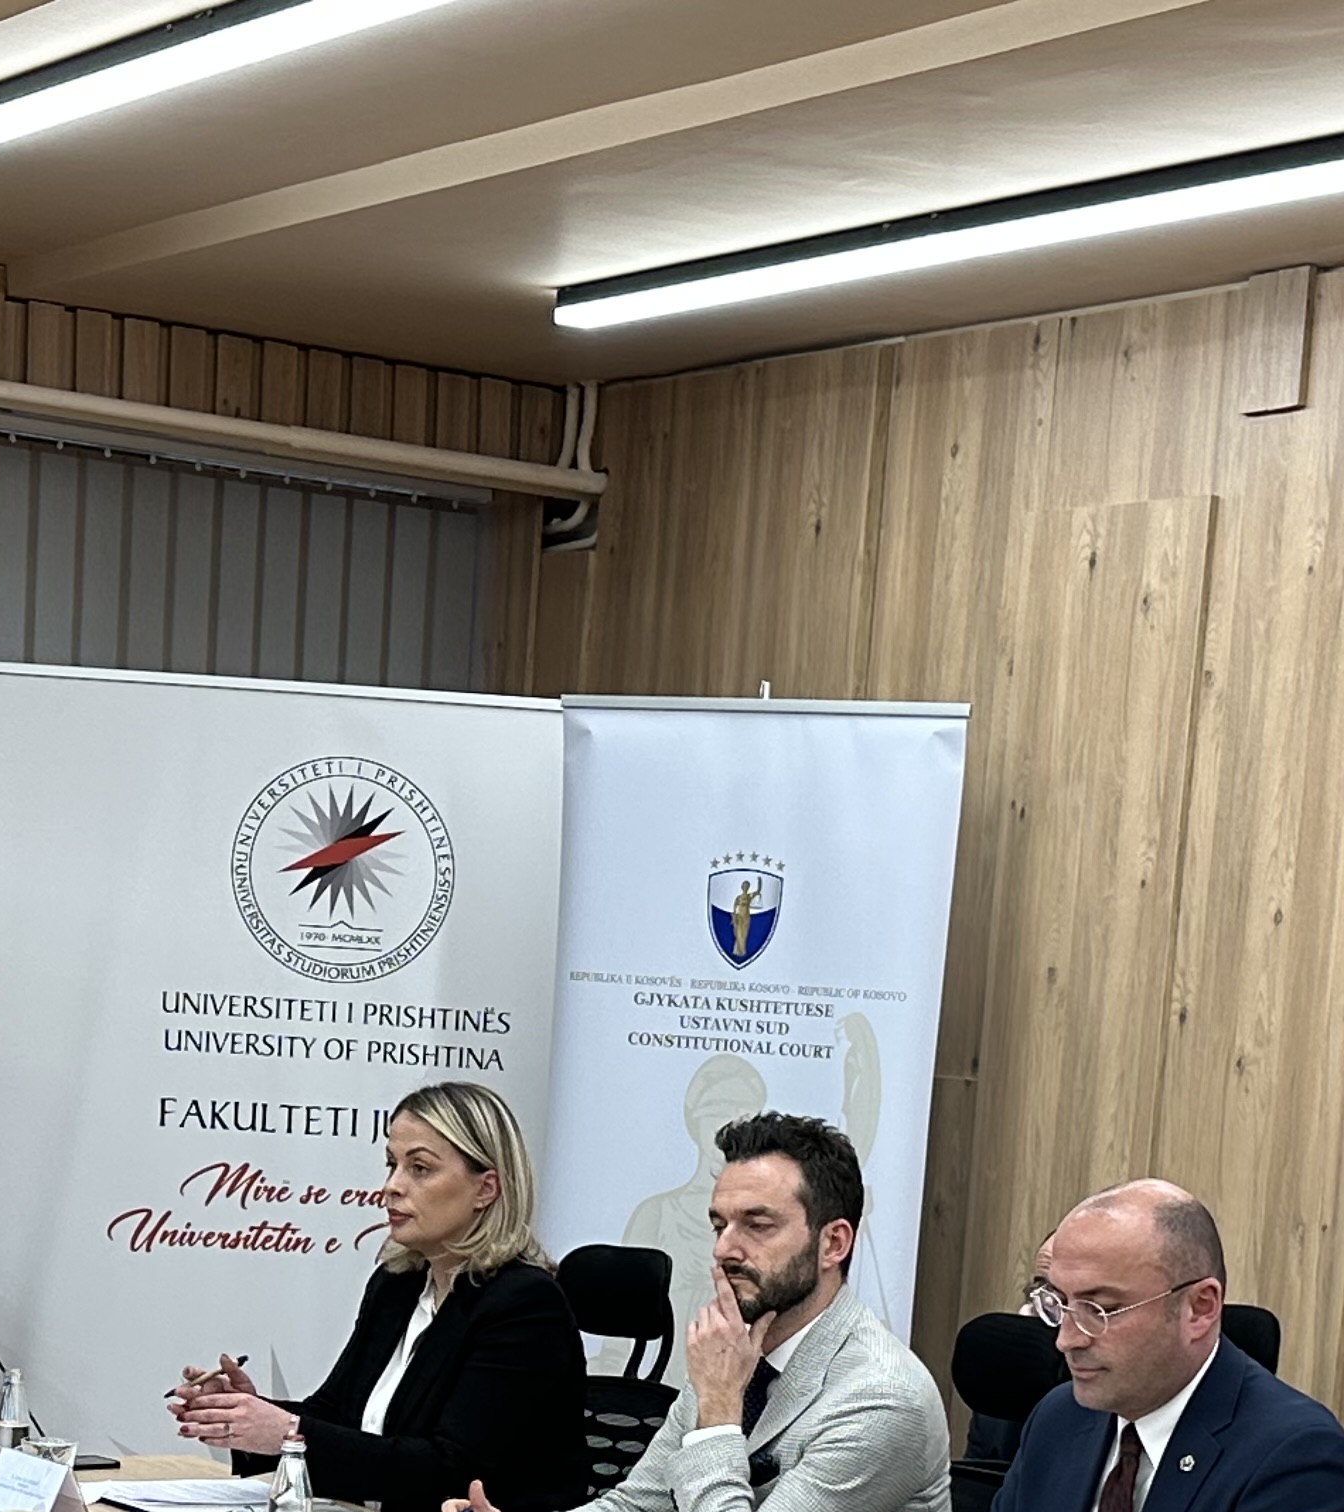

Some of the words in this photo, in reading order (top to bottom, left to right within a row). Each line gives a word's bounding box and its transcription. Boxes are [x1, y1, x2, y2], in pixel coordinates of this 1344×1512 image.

[235, 760, 344, 862] UNIVERSITETI
[234, 863, 285, 956] UNIVERSITAS
[283, 950, 377, 980] STUDIORUM
[299, 932, 327, 942] 1970
[161, 991, 337, 1023] UNIVERSITETI
[347, 1002, 353, 1023] I
[363, 1002, 511, 1035] PRISHTINËS
[633, 991, 712, 1011] GJYKATA
[715, 999, 835, 1018] KUSHTETUESE
[748, 983, 790, 994] KOSOVO
[797, 986, 846, 998] REPUBLIC
[862, 990, 908, 1002] KOSOVO
[628, 1031, 776, 1055] CONSTITUTIONAL
[779, 1042, 834, 1059] COURT
[679, 1015, 751, 1033] USTAVNI
[756, 1020, 790, 1036] SUD
[164, 1029, 316, 1059] UNIVERSITY
[324, 1038, 358, 1061] OF
[367, 1041, 504, 1071] PRISHTINA
[159, 1097, 358, 1137] FAKULTETI
[179, 1162, 294, 1209] Mirë
[299, 1185, 331, 1205] se
[107, 1208, 316, 1254] Universitetin
[325, 1236, 343, 1254] e
